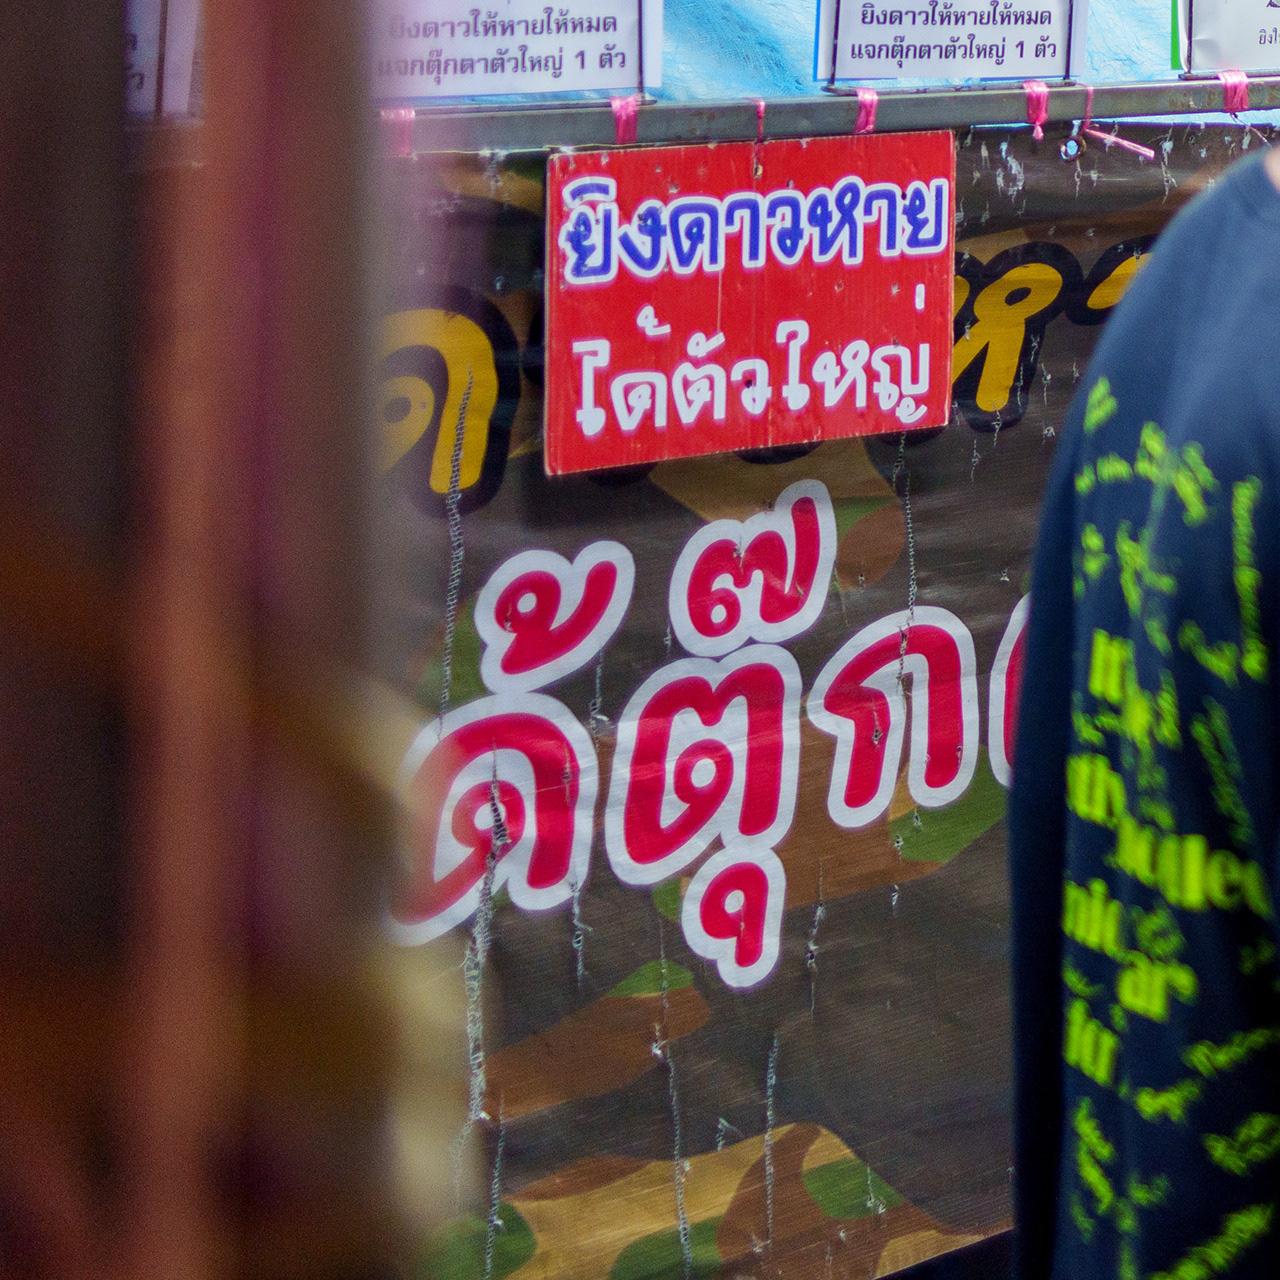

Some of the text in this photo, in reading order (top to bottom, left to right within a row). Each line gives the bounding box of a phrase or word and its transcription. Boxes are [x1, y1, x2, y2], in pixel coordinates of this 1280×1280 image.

[860, 0, 1052, 26] ยิงดาวให้หายให้หมด
[574, 50, 587, 70] 1
[598, 43, 627, 70] ตัว
[850, 33, 1057, 69] แจกตุ๊กตาตัวใหญ่ 1 ตัว
[557, 173, 950, 287] ยิงดาวหาย
[570, 282, 931, 437] ได้ตัวใหญ่
